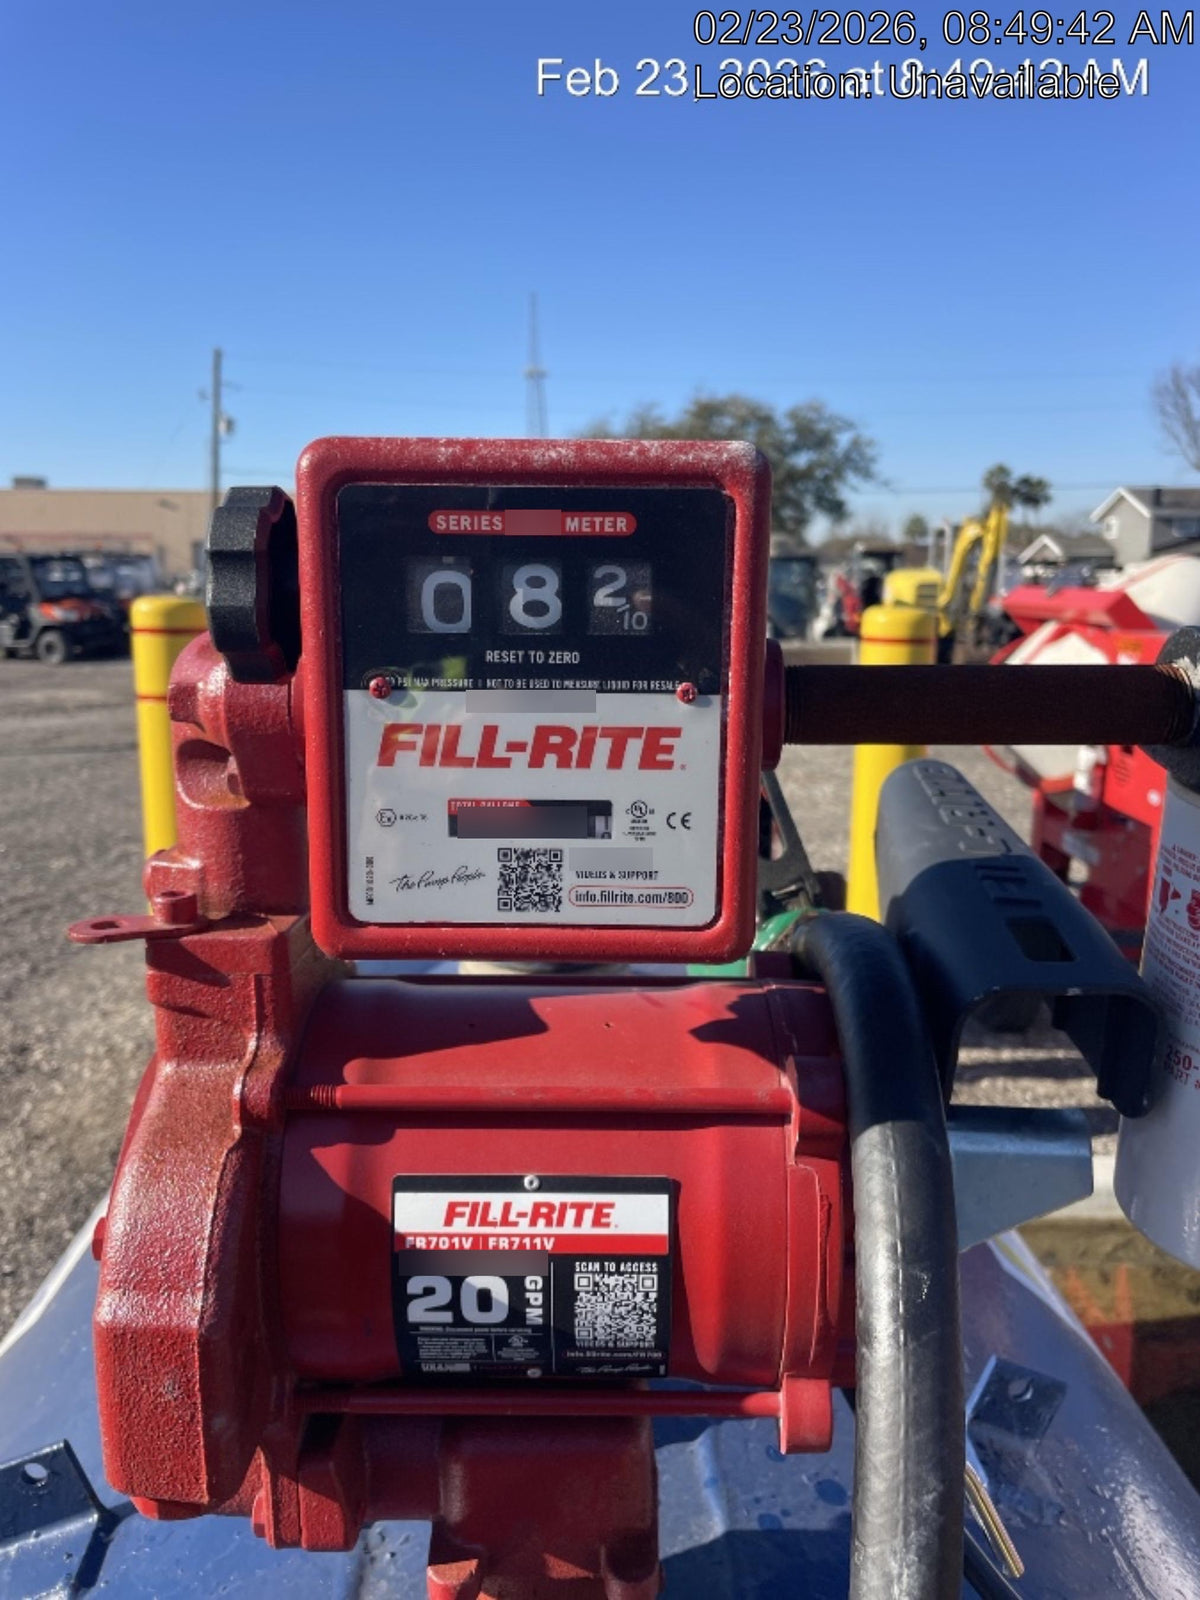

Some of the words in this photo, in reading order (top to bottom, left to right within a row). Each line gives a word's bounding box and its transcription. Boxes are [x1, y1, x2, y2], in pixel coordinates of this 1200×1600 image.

[436, 515, 504, 531] SERIES
[565, 516, 628, 533] METER
[421, 570, 472, 633] 0
[509, 563, 562, 629] 8
[593, 565, 628, 607] 2
[485, 650, 525, 664] RESET
[529, 651, 545, 664] TO
[548, 651, 580, 665] ZERO
[377, 723, 684, 770] FILL-RITE
[618, 871, 658, 880] SUPPORT
[443, 1201, 616, 1228] FILL-RITE
[405, 1237, 473, 1250] FR701V
[488, 1237, 555, 1250] FR711V
[575, 1262, 600, 1272] SCAN
[604, 1262, 616, 1272] TO
[620, 1262, 658, 1272] ACCESS
[406, 1275, 509, 1324] 20
[524, 1275, 543, 1325] GPM
